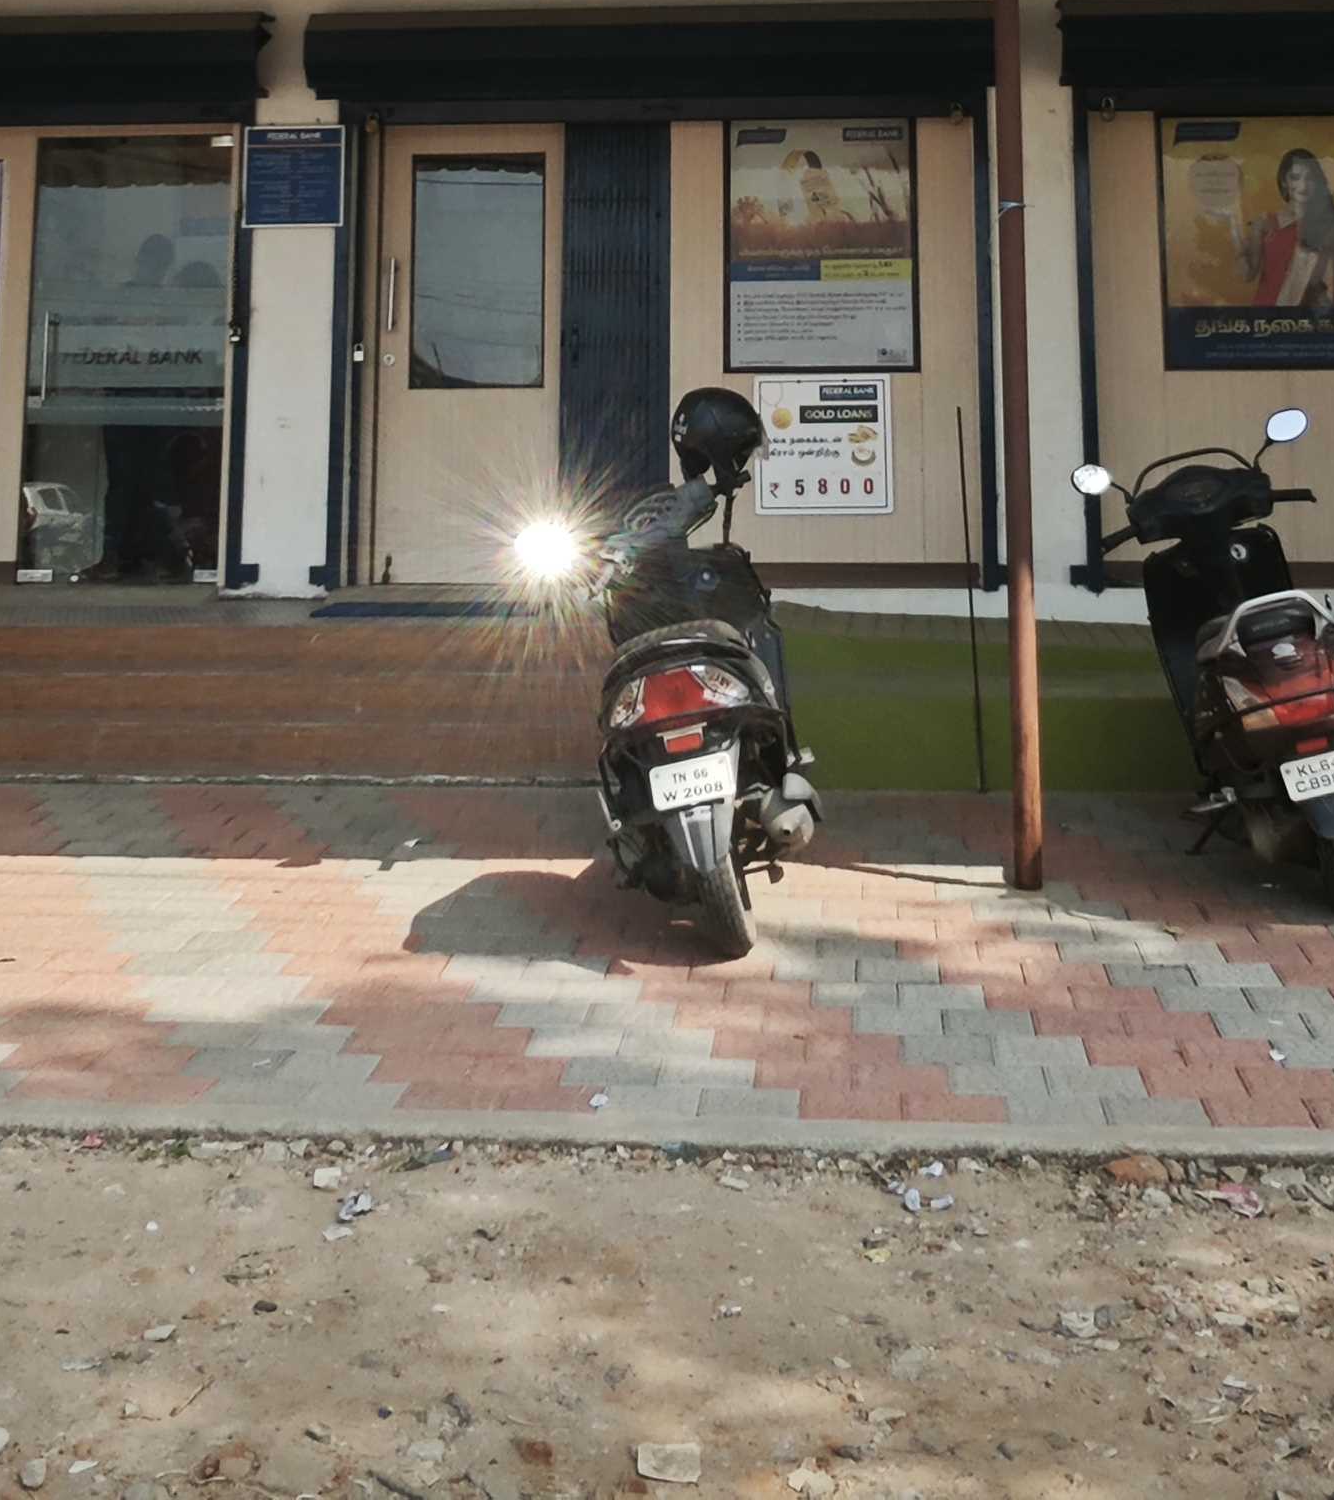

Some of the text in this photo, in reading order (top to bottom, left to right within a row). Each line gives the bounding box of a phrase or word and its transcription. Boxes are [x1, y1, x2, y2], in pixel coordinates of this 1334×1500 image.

[1195, 317, 1251, 338] தங்க
[1253, 317, 1314, 338] நகை
[804, 408, 873, 419] GOLD LOANS
[683, 780, 724, 799] 2008
